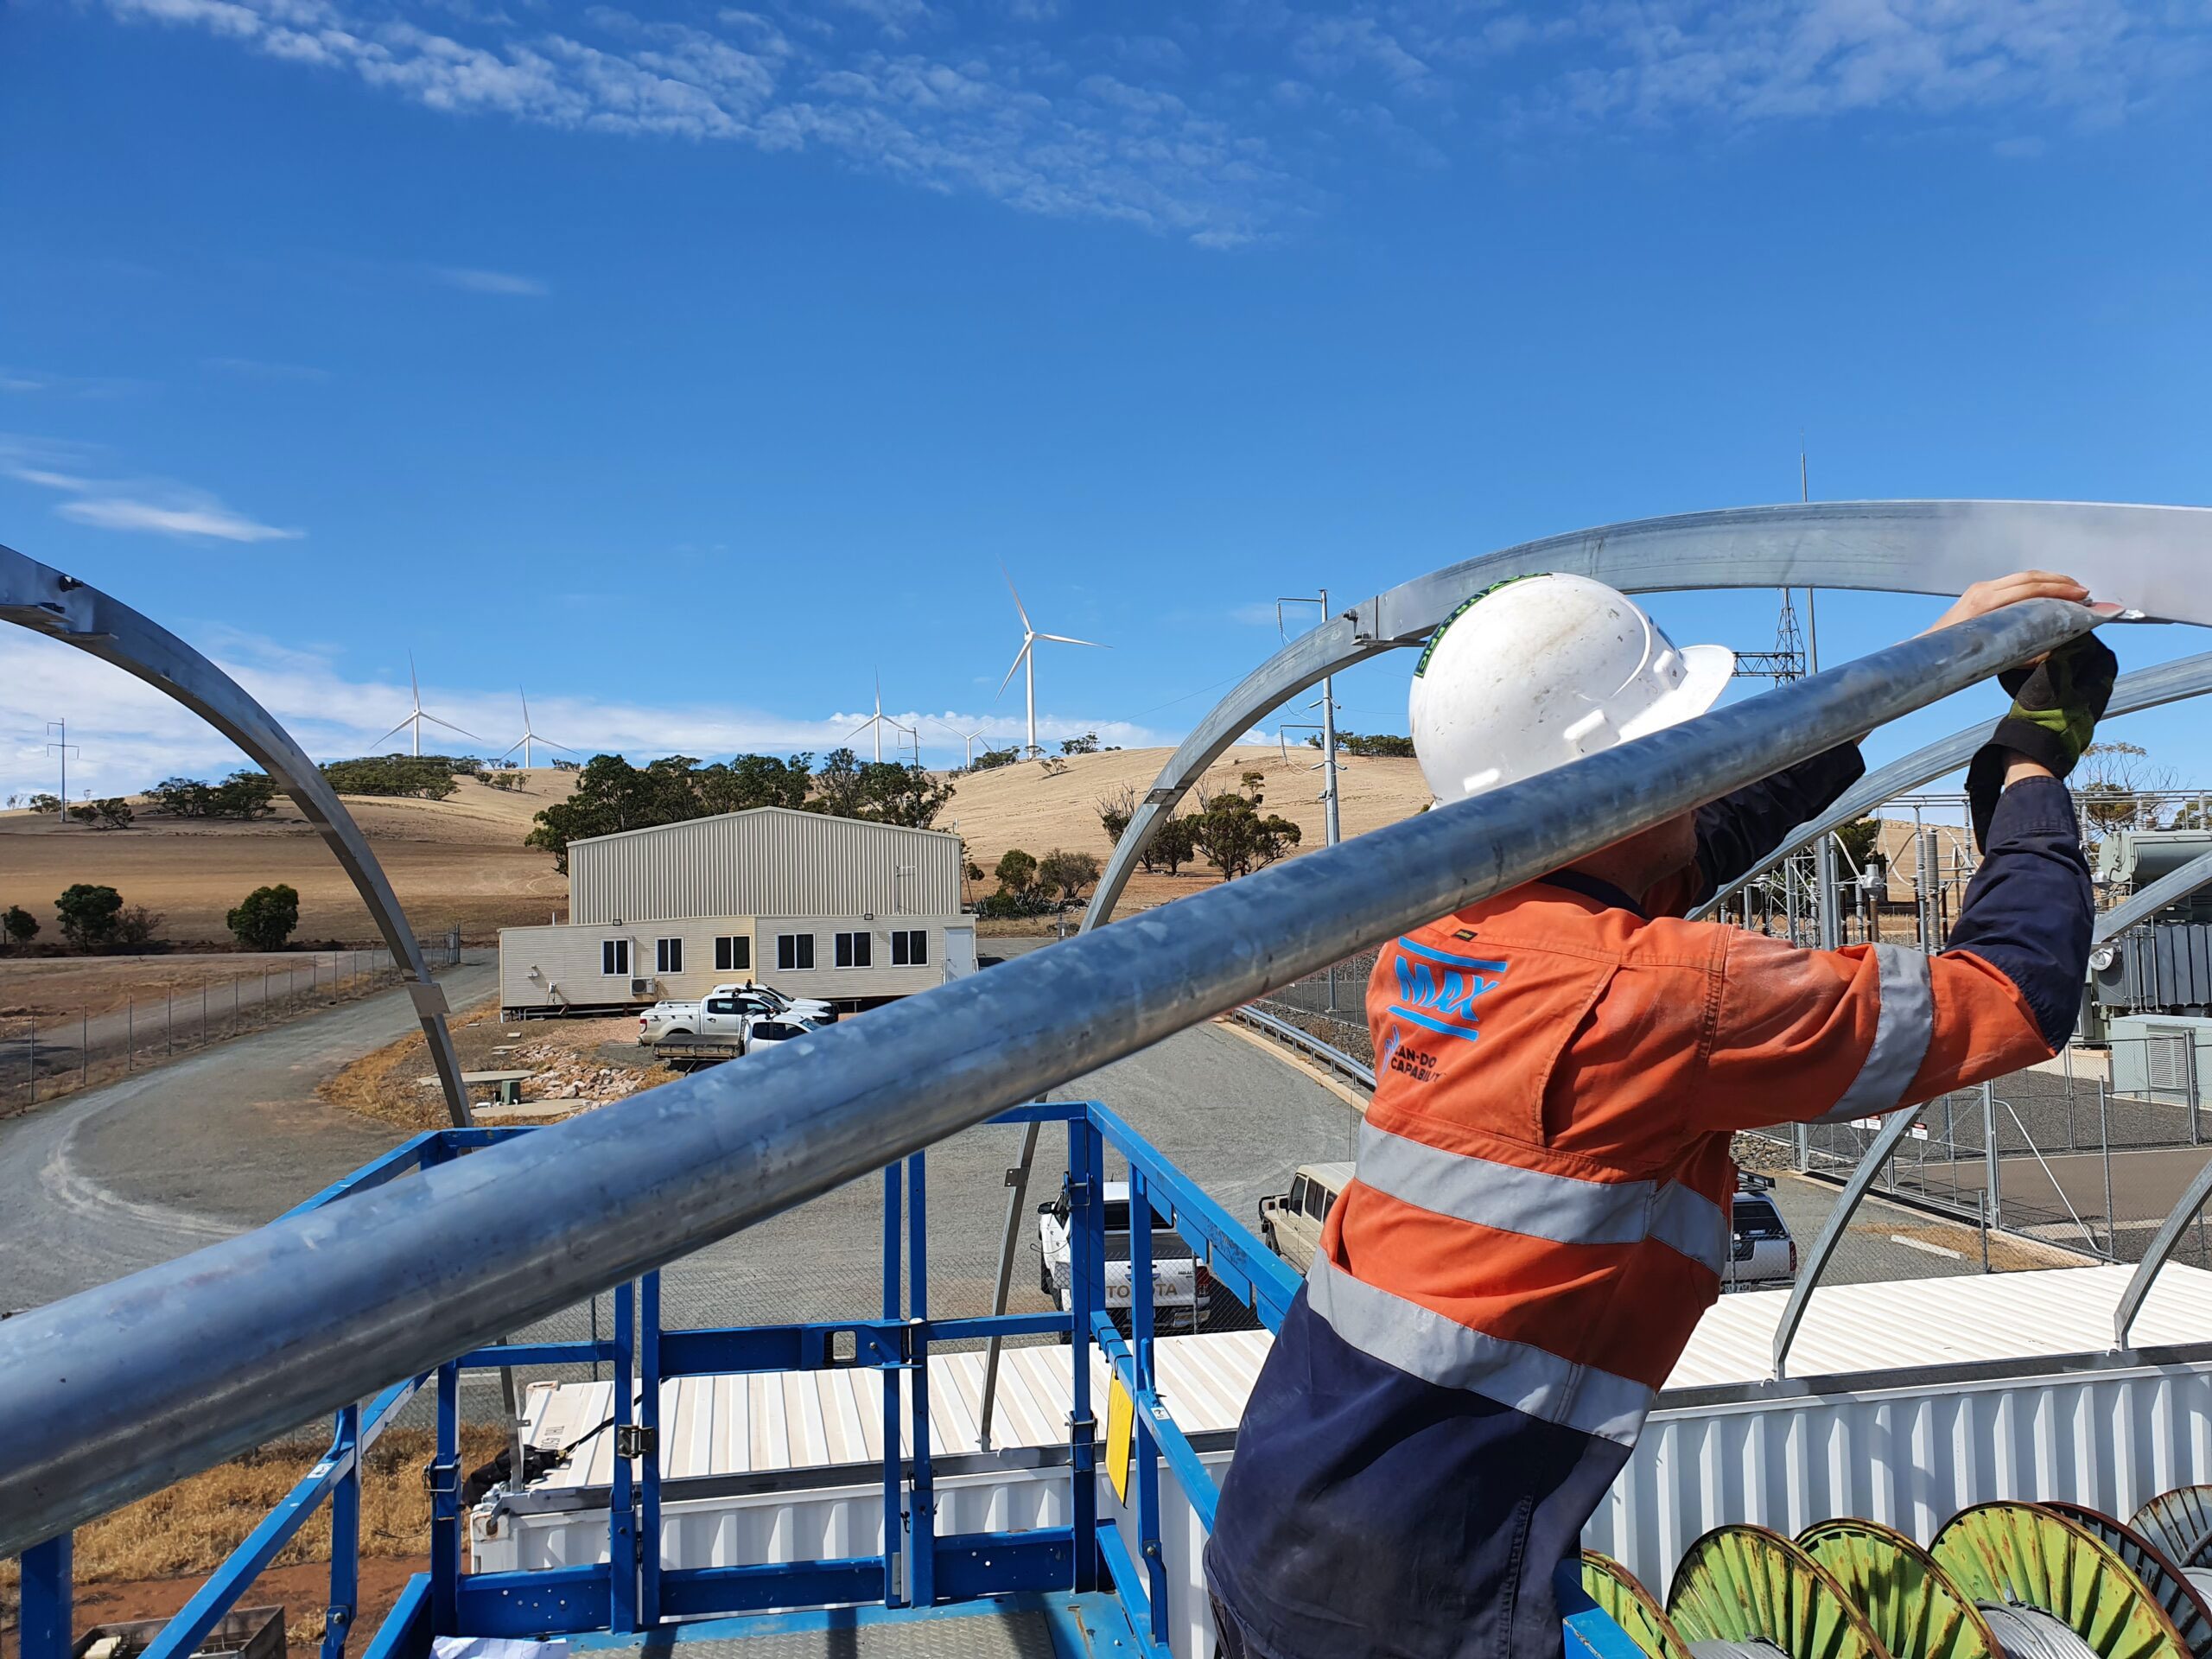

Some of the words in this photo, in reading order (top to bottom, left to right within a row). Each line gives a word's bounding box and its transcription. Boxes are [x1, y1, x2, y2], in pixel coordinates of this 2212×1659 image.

[1395, 955, 1500, 1022] MAX
[1395, 1045, 1438, 1069] AN-DO
[1106, 1283, 1179, 1299] TOTA
